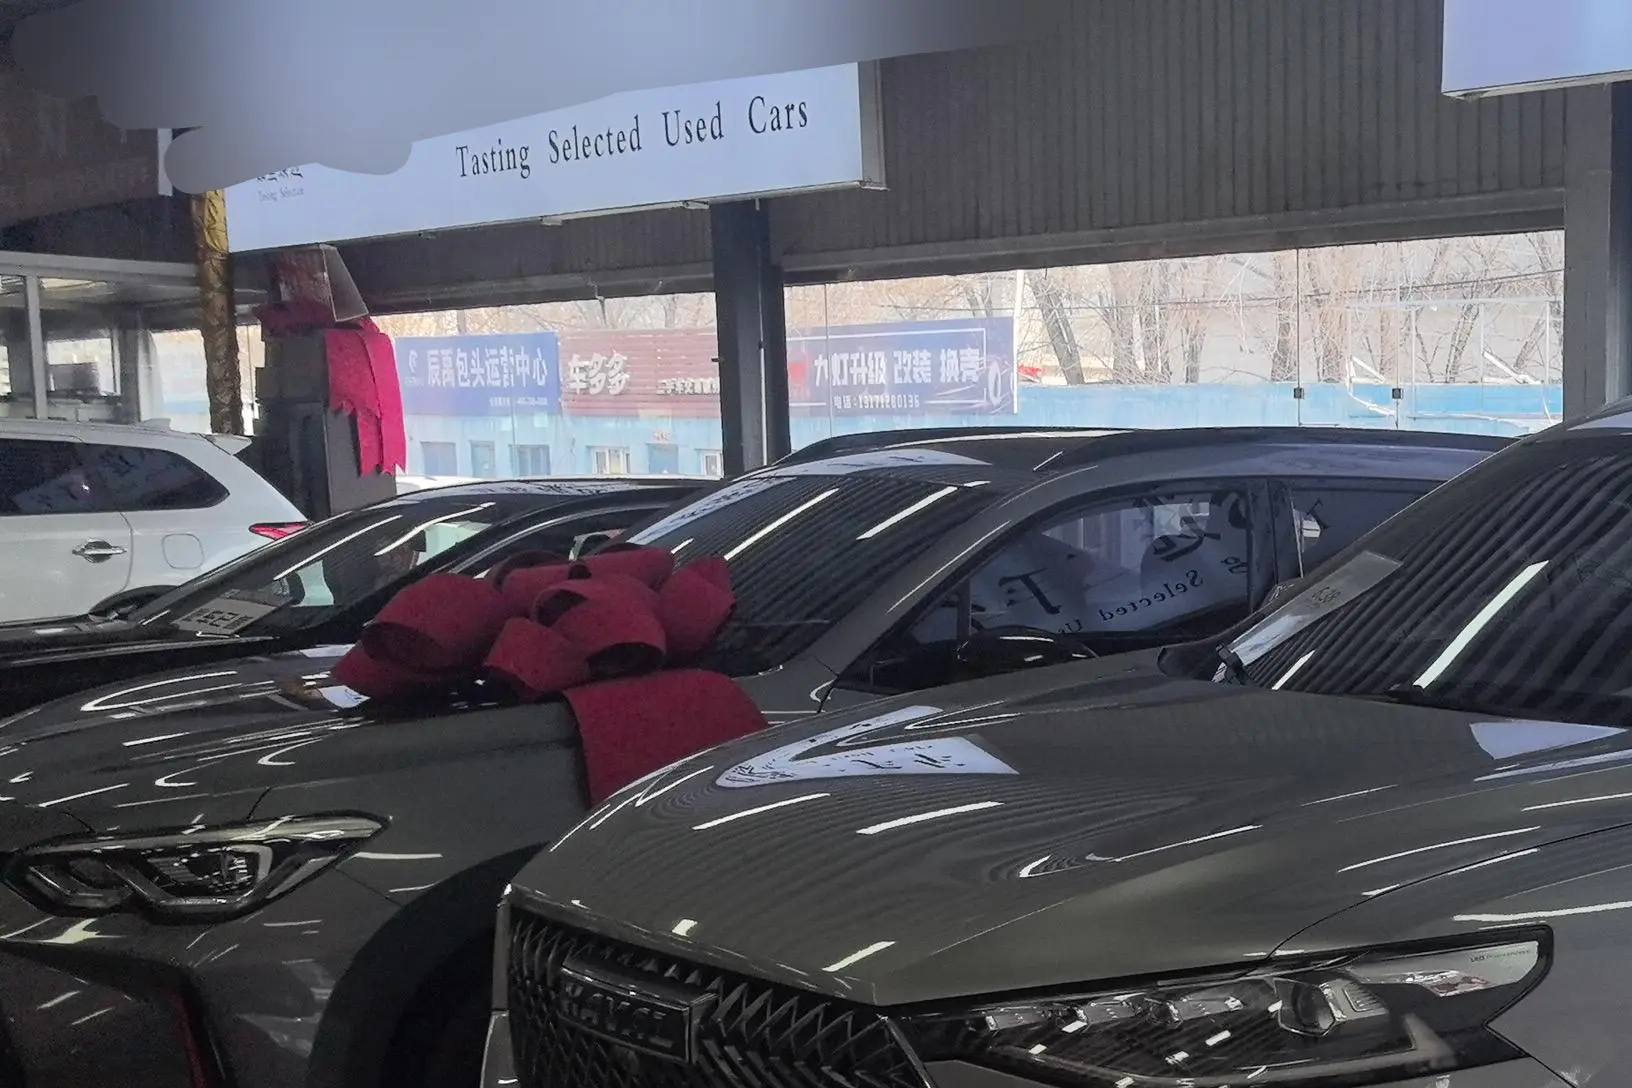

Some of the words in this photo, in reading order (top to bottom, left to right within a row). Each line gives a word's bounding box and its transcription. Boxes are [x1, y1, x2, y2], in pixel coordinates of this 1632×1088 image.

[456, 138, 531, 179] Tasting
[548, 114, 642, 164] Selected
[662, 101, 724, 147] Used
[748, 95, 808, 134] Cars
[568, 349, 630, 396] 车多多
[893, 349, 932, 384] 改装
